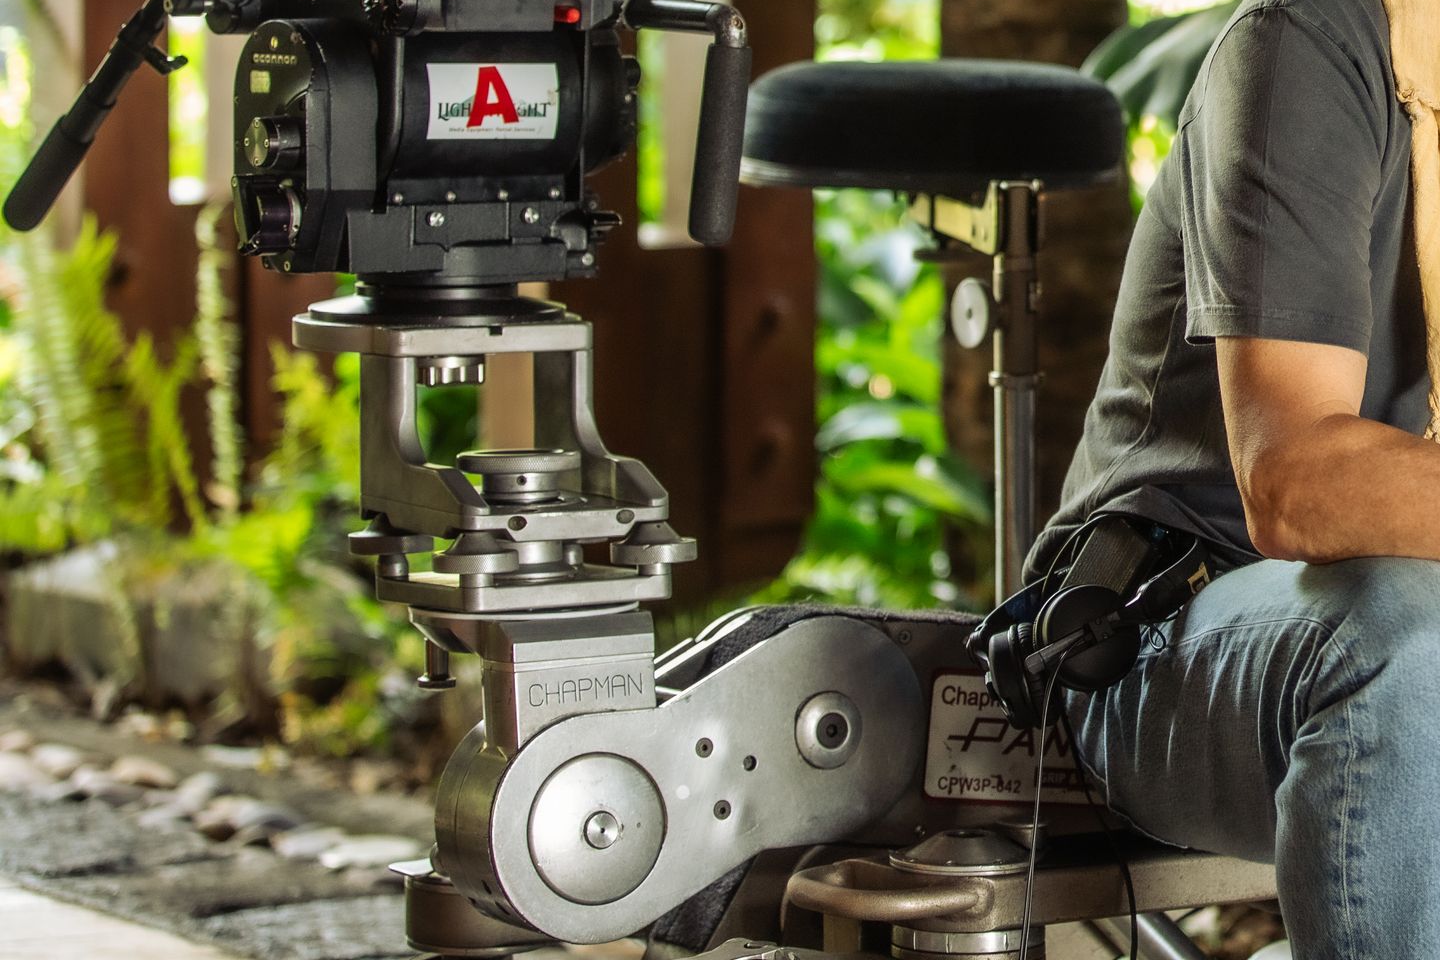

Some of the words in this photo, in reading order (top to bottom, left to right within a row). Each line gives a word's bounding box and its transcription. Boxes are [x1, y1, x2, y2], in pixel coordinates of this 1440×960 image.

[437, 102, 471, 121] LIGH
[466, 66, 519, 128] A
[528, 672, 643, 707] CHAPMAN
[947, 717, 1072, 758] PAN
